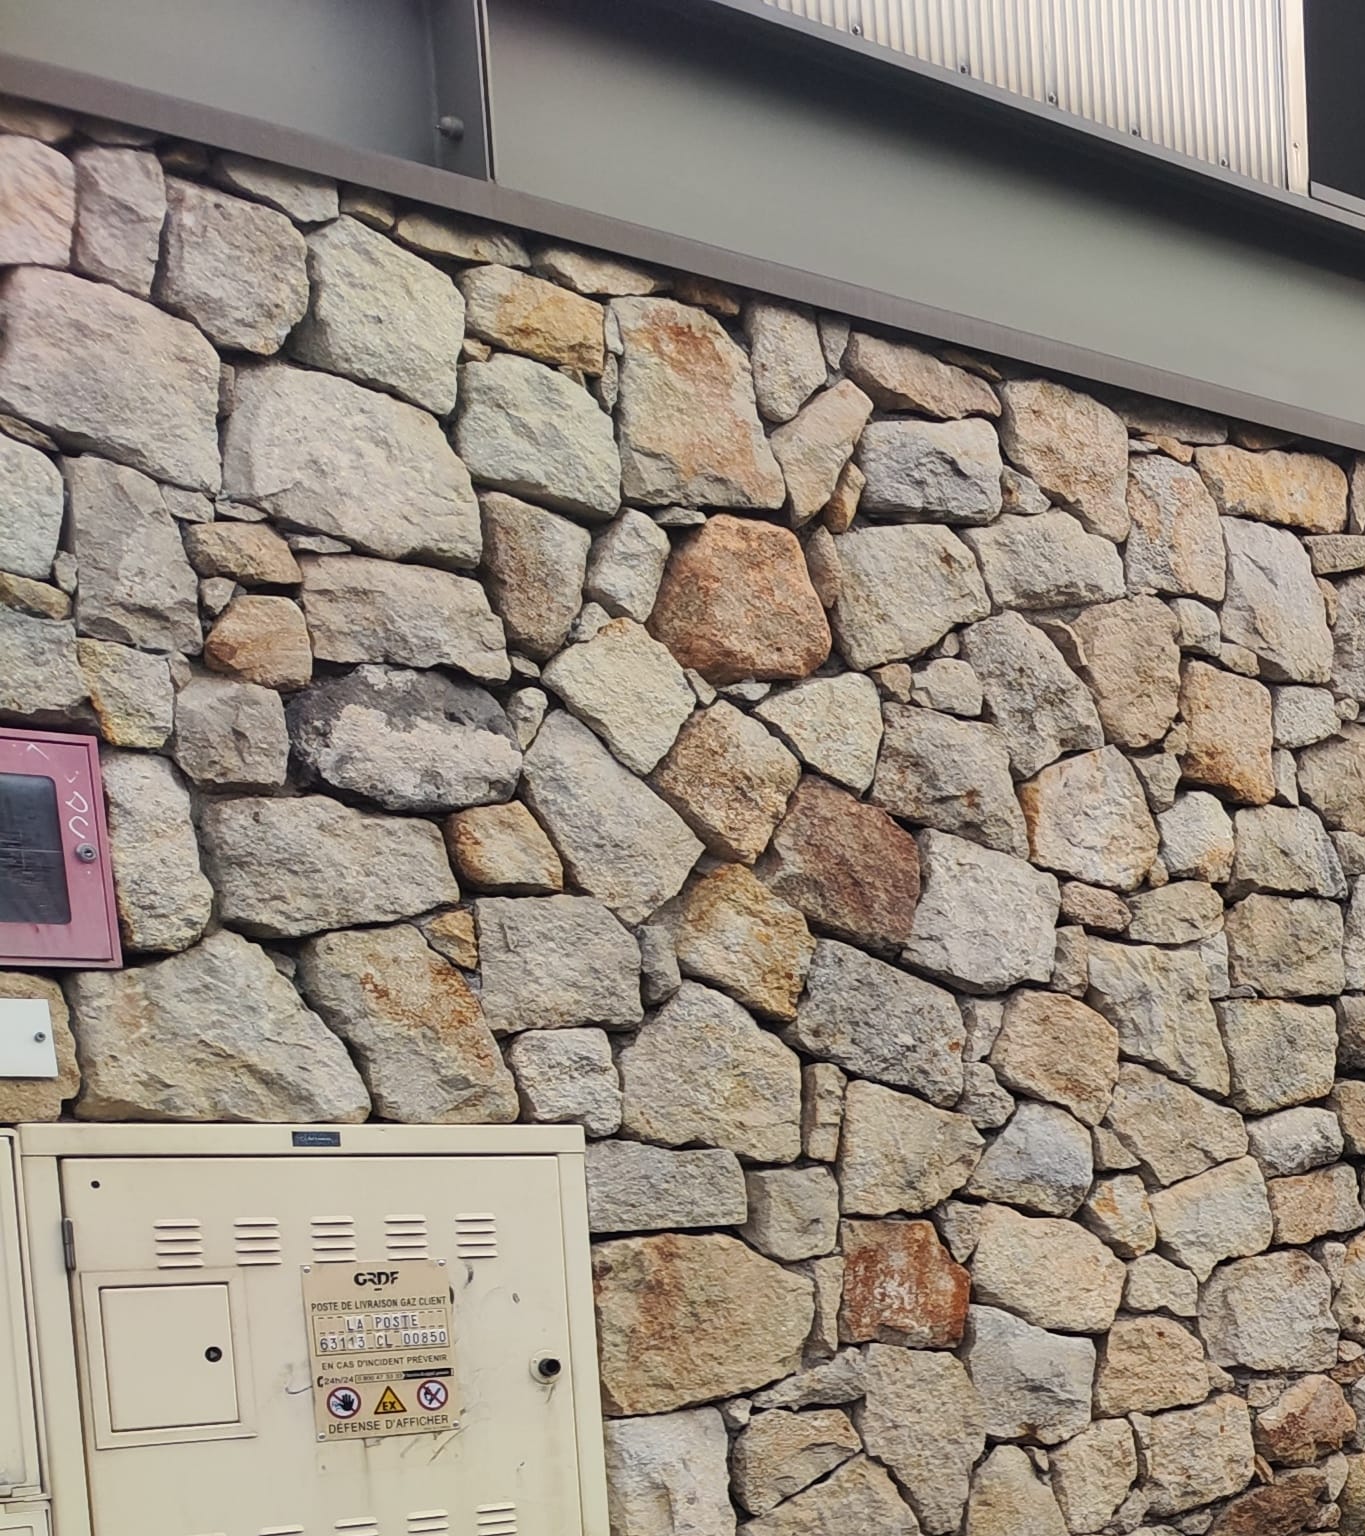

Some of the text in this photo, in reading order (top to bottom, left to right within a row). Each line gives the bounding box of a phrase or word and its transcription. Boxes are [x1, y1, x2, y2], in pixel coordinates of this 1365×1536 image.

[353, 1271, 399, 1286] GRDF
[311, 1295, 446, 1312] POSTE DE LIVRAISON GAZ CLIENT
[346, 1314, 418, 1331] LA POSTE
[376, 1334, 394, 1347] CL
[403, 1330, 447, 1345] 00850
[321, 1361, 334, 1370] EN
[336, 1360, 355, 1369] CAS
[357, 1357, 404, 1368] D'INCIDENT
[382, 1401, 397, 1411] EX
[385, 1414, 449, 1430] D'AFFICHER
